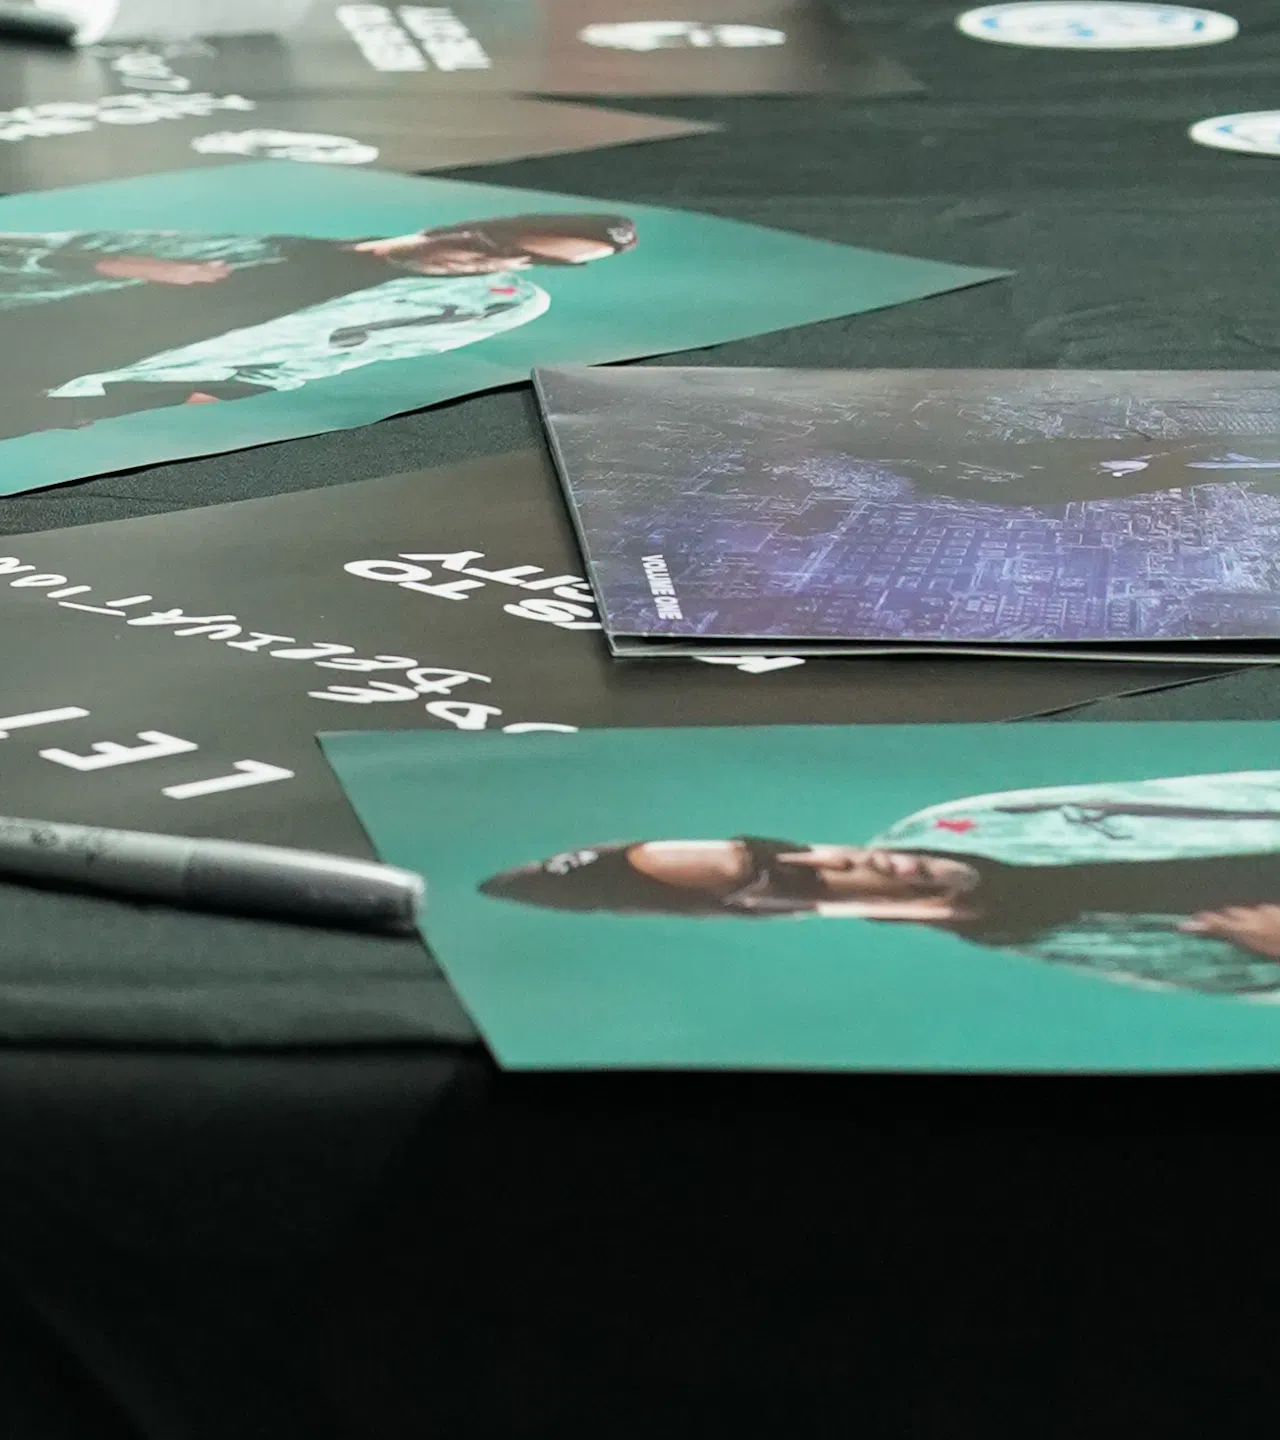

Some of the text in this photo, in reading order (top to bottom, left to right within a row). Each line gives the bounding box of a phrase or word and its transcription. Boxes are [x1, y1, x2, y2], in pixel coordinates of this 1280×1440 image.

[343, 559, 485, 601] TO
[641, 554, 683, 620] VOLUME ONE
